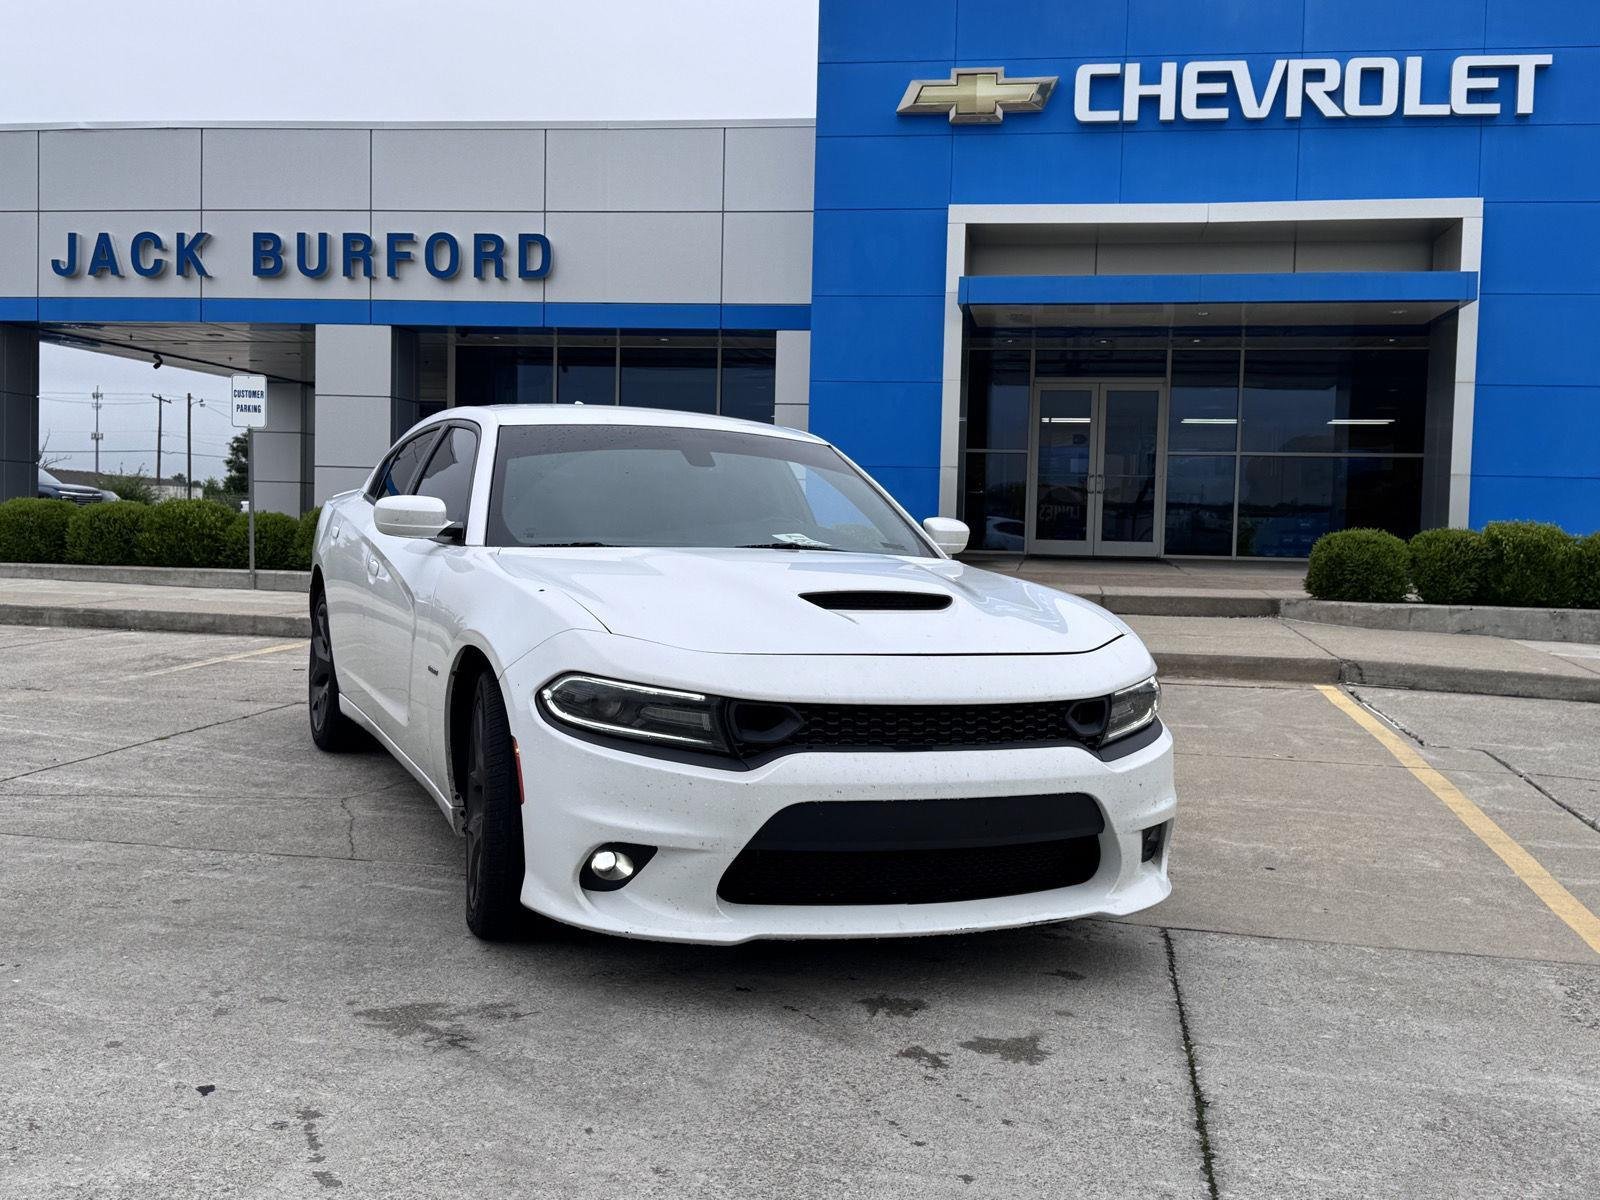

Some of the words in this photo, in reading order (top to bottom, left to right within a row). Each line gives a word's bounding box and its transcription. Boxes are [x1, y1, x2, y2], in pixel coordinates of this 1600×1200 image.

[1073, 53, 1554, 124] CHEVROLET
[51, 231, 213, 279] JACK
[252, 231, 554, 280] BURFORD
[233, 389, 265, 399] CUSTOMER
[236, 404, 262, 413] PARKING
